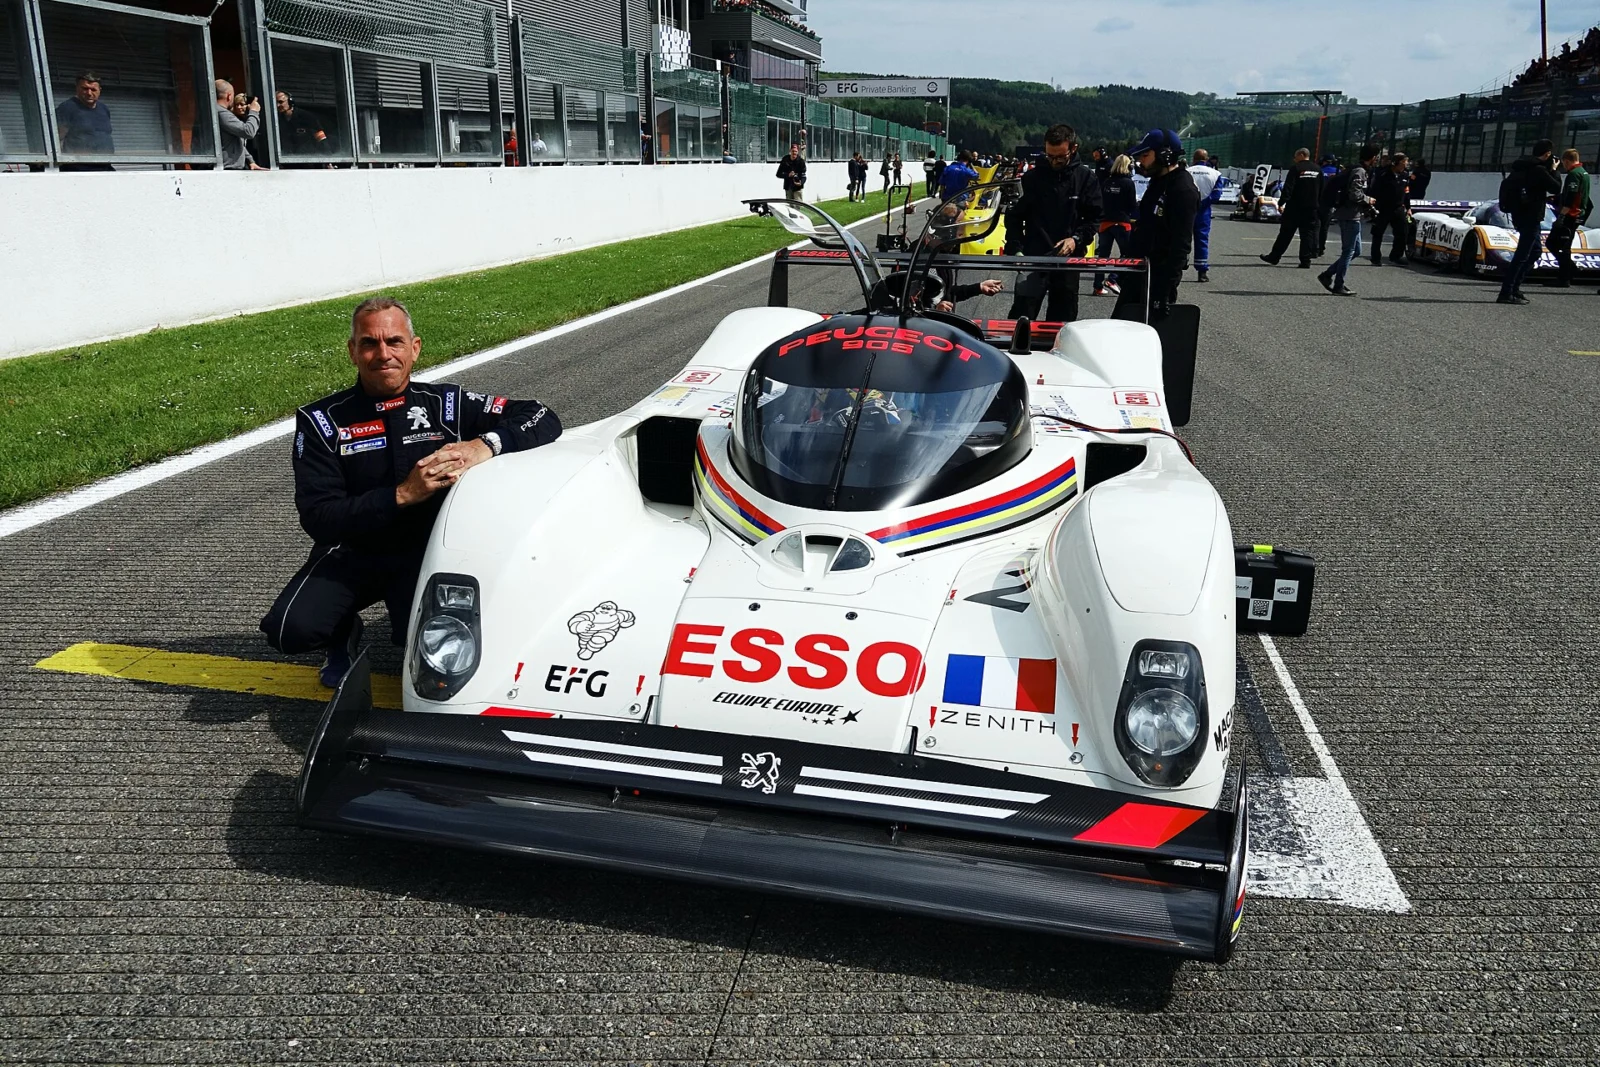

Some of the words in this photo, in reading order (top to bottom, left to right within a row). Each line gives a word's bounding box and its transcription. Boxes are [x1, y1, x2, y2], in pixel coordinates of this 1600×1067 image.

[837, 83, 858, 93] EFG
[887, 86, 917, 94] Banking
[1254, 166, 1268, 191] Cut
[175, 187, 181, 197] 4
[1439, 223, 1454, 244] Cut
[1066, 257, 1143, 265] DASSAULT
[779, 327, 982, 362] PEUGEOT
[842, 339, 914, 354] 905
[385, 400, 405, 408] TOTAL
[446, 391, 455, 421] sparco
[312, 410, 334, 437] sparco
[350, 425, 383, 435] TOTAL
[659, 623, 926, 697] ESSO
[544, 664, 610, 698] EFG
[712, 691, 776, 709] EQUIPE
[773, 699, 844, 717] EUROPE
[940, 709, 1056, 734] ZENITH
